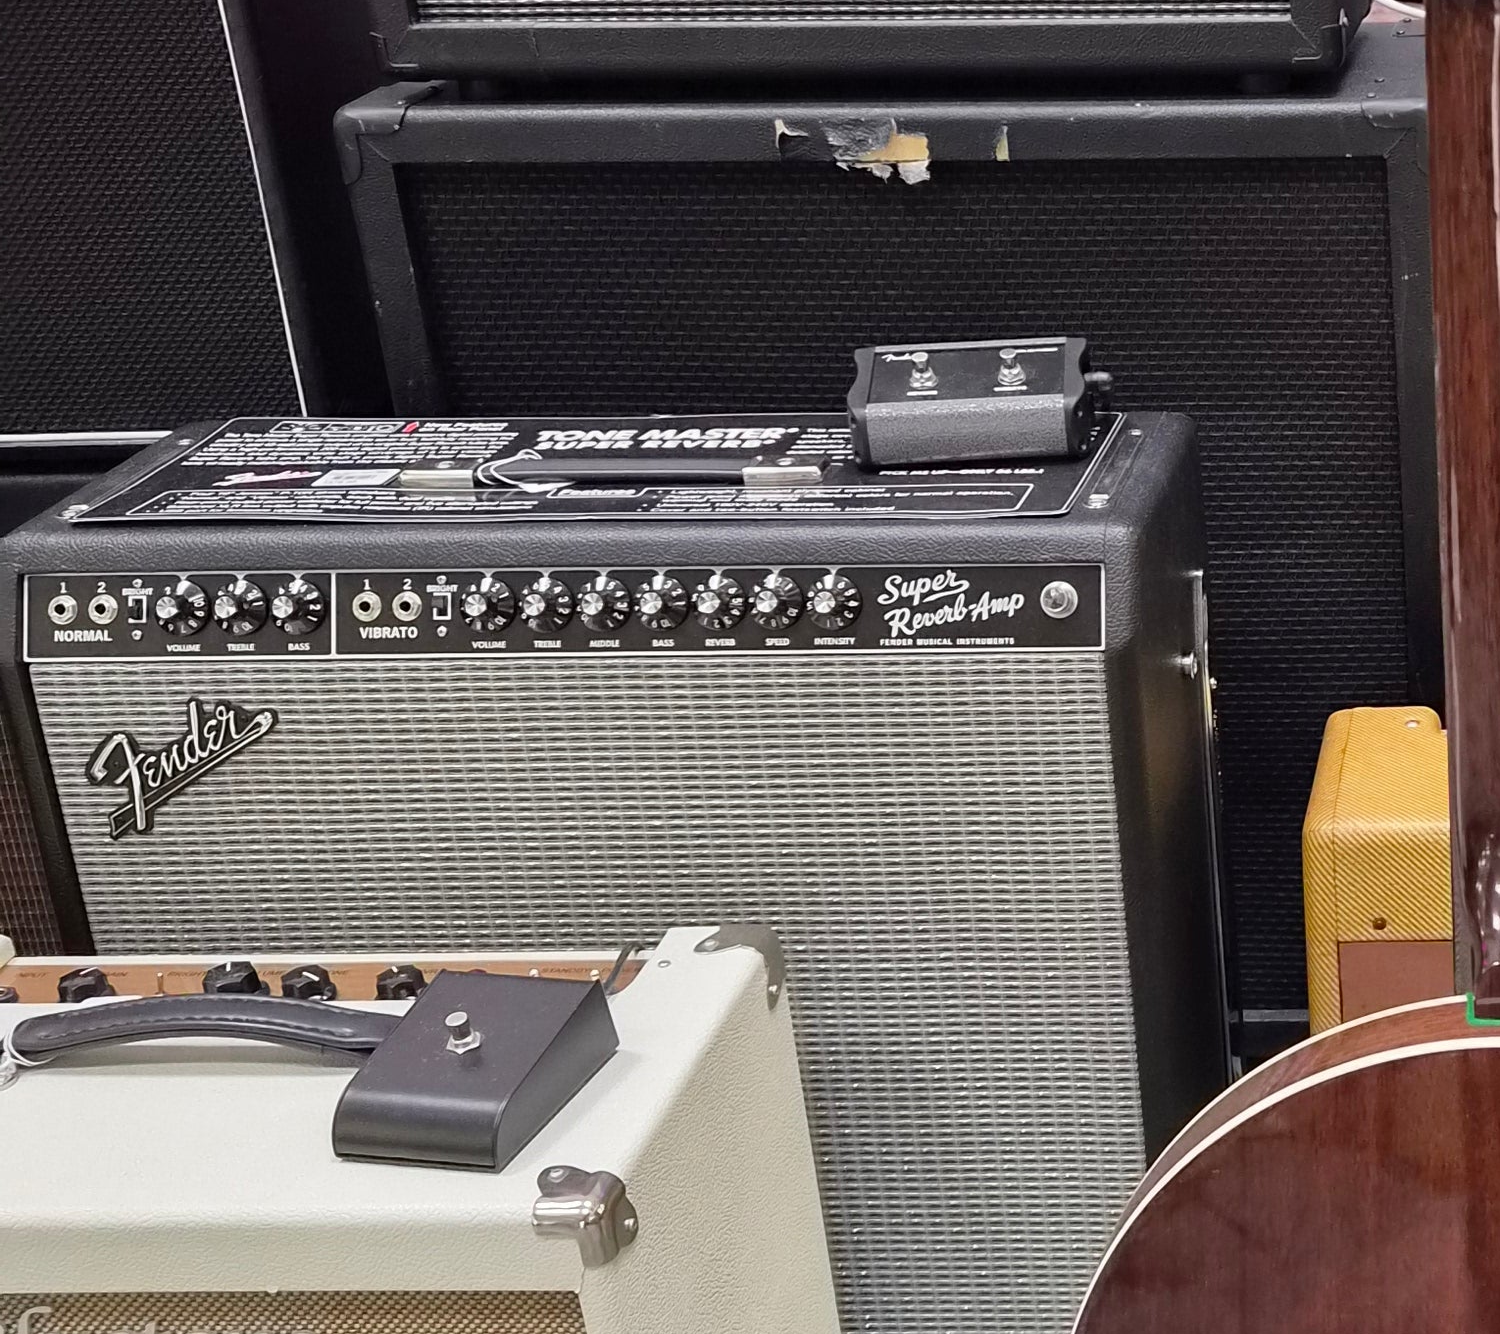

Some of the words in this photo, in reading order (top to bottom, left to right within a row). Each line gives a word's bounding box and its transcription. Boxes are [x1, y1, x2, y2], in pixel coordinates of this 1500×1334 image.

[536, 430, 638, 442] TONE
[534, 440, 634, 450] SUPER
[557, 489, 636, 497] Features
[60, 581, 68, 594] 1
[97, 581, 107, 593] 2
[363, 578, 371, 590] 1
[402, 578, 412, 590] 2
[426, 584, 459, 593] BRIGHT
[877, 569, 970, 606] Super
[122, 587, 154, 596] BRIGHT
[883, 590, 1025, 638] Reverb-Amp
[54, 629, 113, 642] NORMAL
[359, 626, 418, 639] VIBRATO
[471, 640, 507, 649] VOLUME
[533, 640, 562, 648] TREBLE
[589, 639, 620, 648] MIDDLE
[652, 639, 675, 647] BASS
[705, 638, 736, 647] REVERB
[764, 638, 790, 646] SPEED
[813, 637, 856, 646] INTENSITY
[879, 638, 913, 646] FENDER
[916, 638, 953, 646] MUSICAL
[956, 637, 1015, 645] INSTRUMENTS
[166, 643, 201, 652] VOLUME
[226, 643, 256, 651] TREBLE
[287, 642, 311, 651] BASS
[90, 701, 273, 833] Fender
